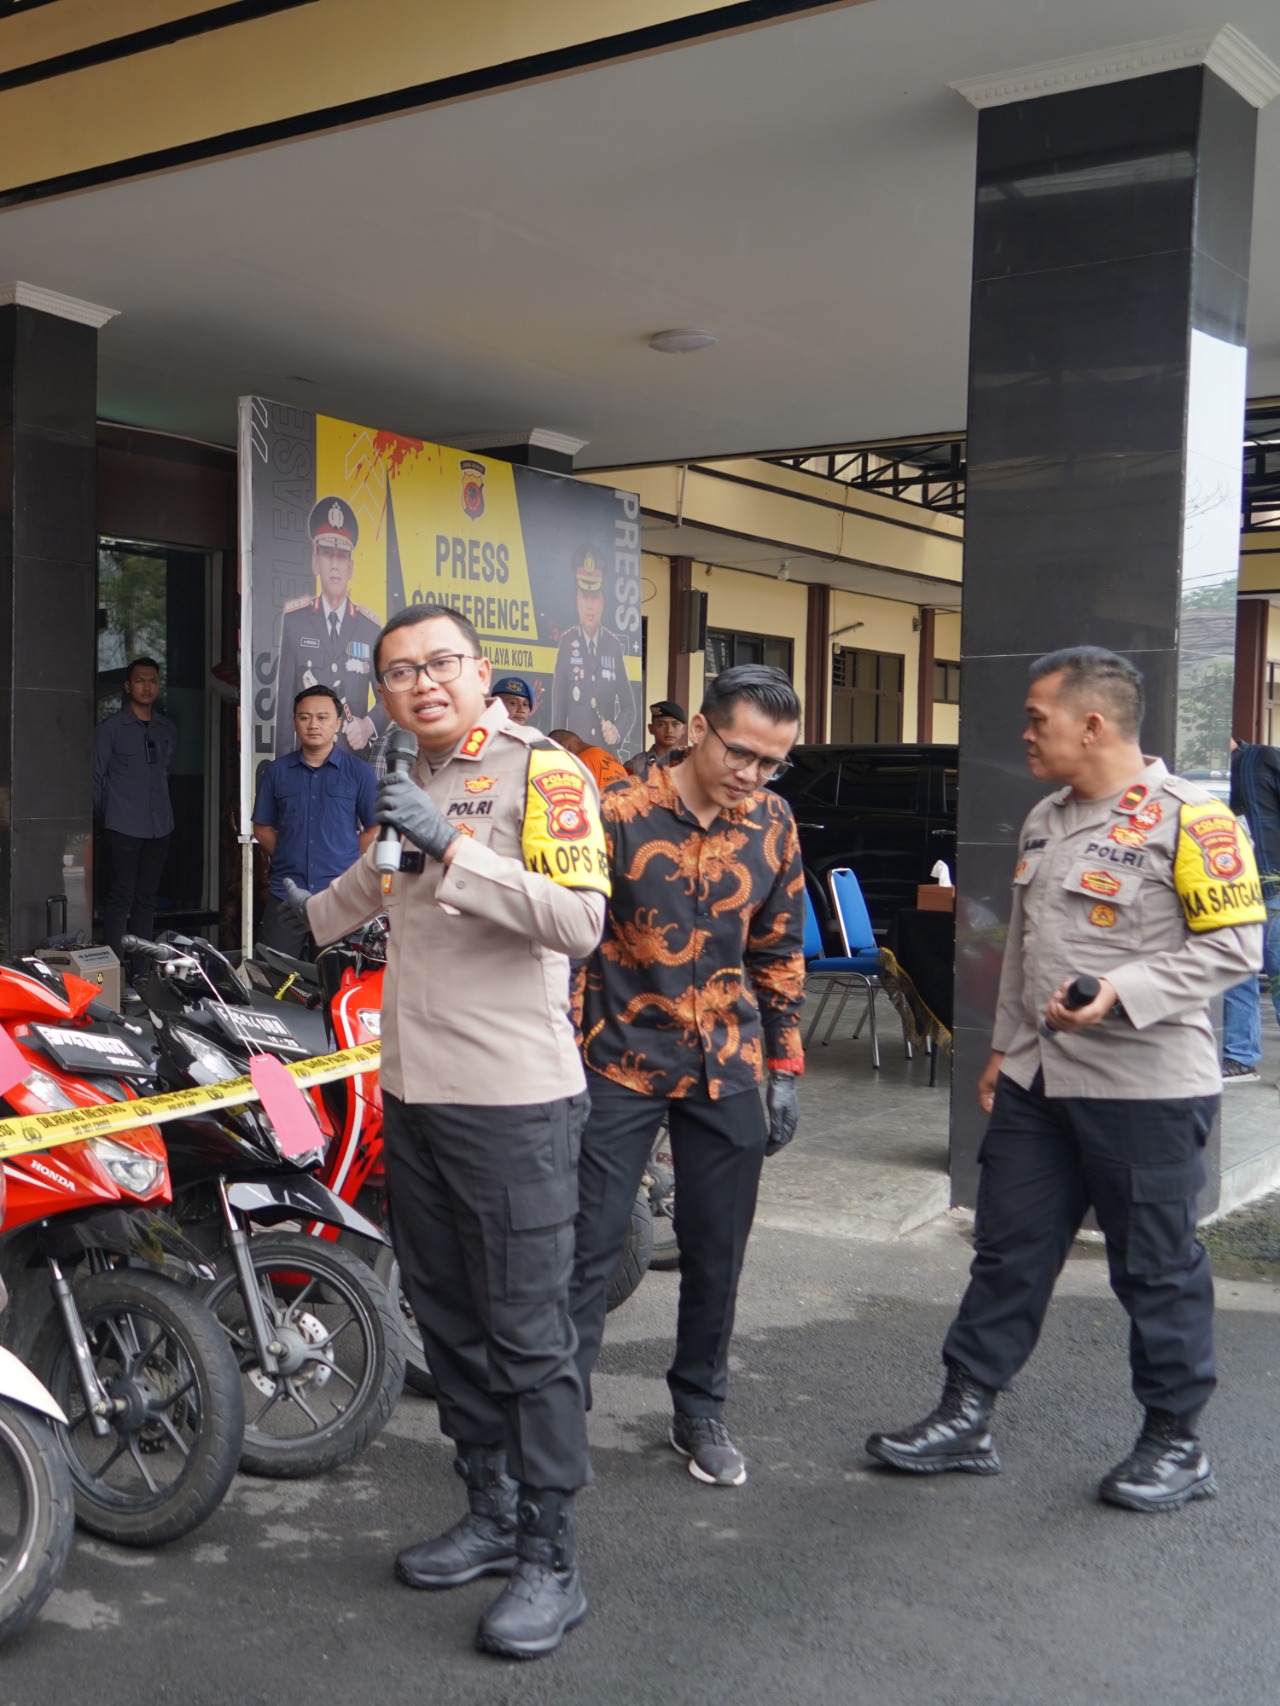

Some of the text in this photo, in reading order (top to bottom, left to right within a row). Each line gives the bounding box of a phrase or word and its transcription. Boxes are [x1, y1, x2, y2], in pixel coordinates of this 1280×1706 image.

[436, 535, 509, 584] PRESS
[615, 489, 640, 632] PRESS
[512, 649, 533, 668] KOTA
[447, 800, 493, 816] POLRI
[556, 846, 593, 875] OPS
[1085, 843, 1144, 867] POLRI
[1182, 890, 1208, 919] KA
[36, 1104, 126, 1129] DILARANG MELINTAS
[31, 1160, 76, 1192] HONDA
